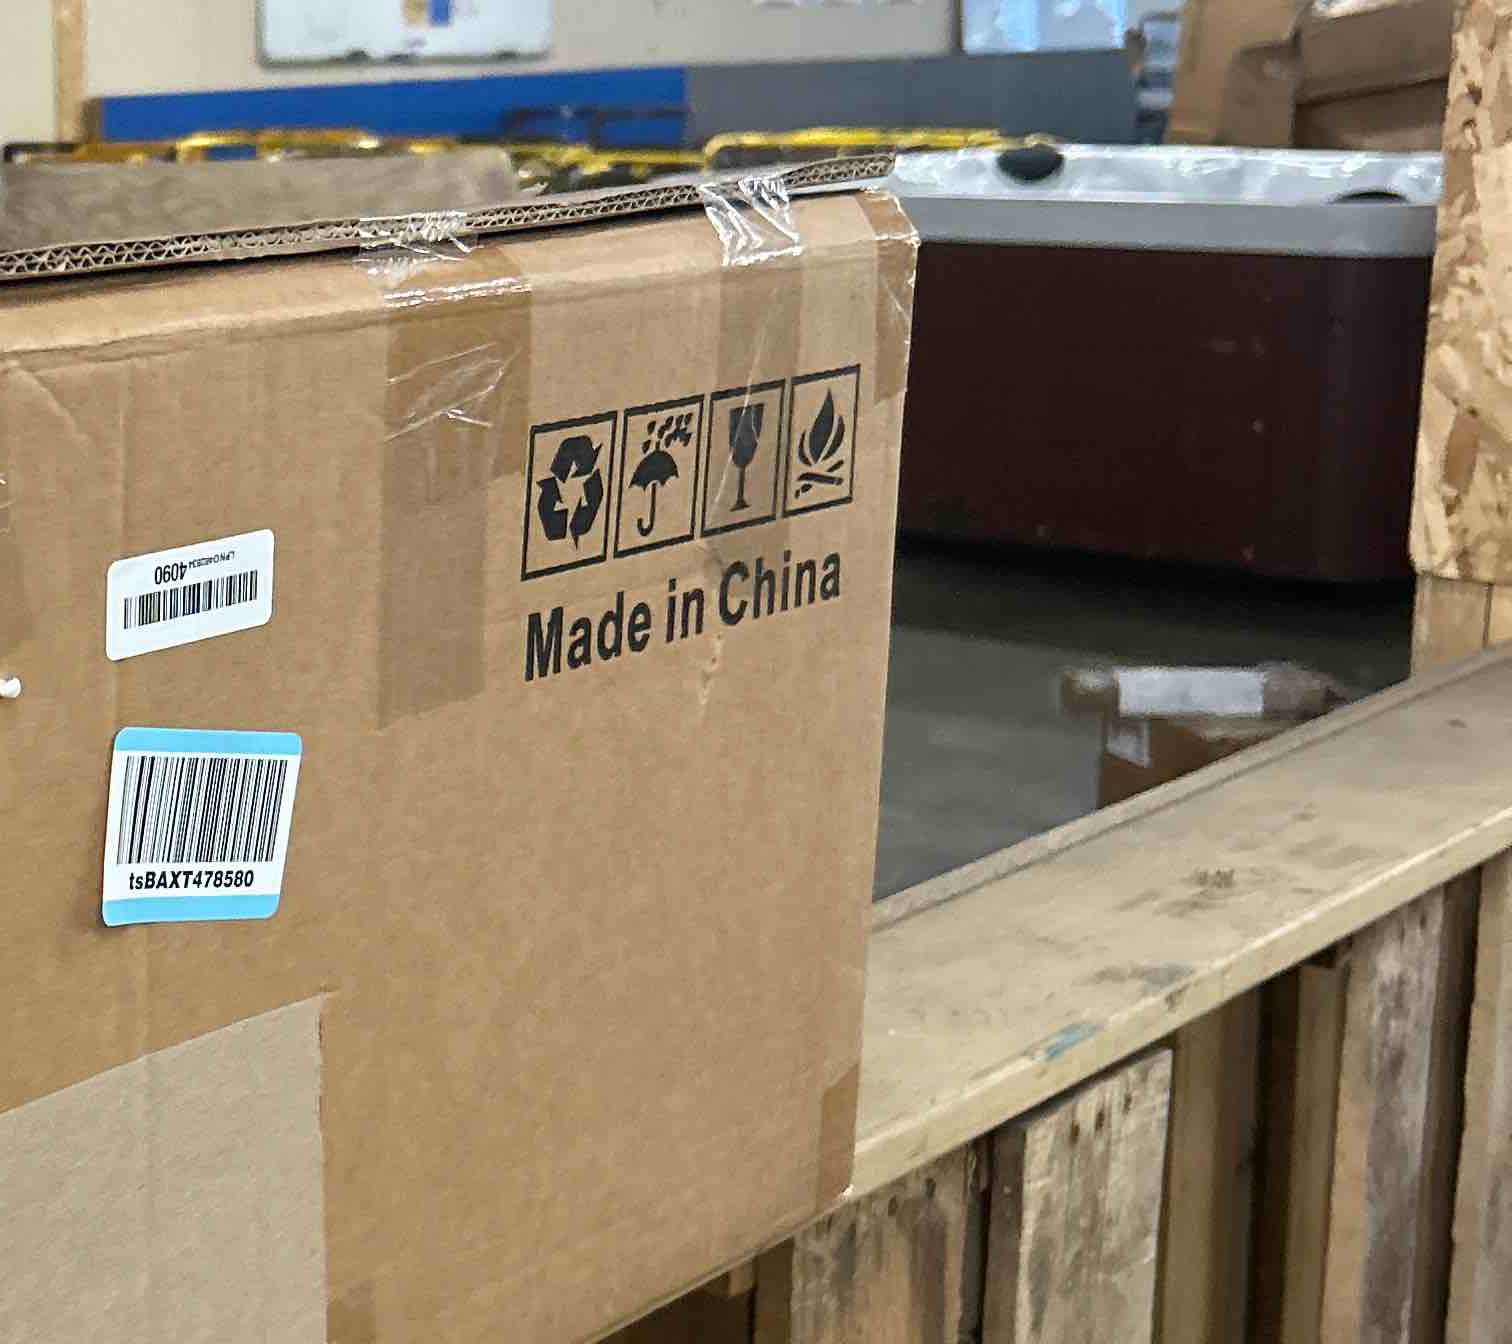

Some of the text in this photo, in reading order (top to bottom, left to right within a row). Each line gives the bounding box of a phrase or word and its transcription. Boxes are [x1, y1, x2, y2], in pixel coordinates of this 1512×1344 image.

[154, 561, 188, 585] 4090
[524, 549, 841, 683] Made in China
[128, 870, 255, 892] tsBAXT478580
